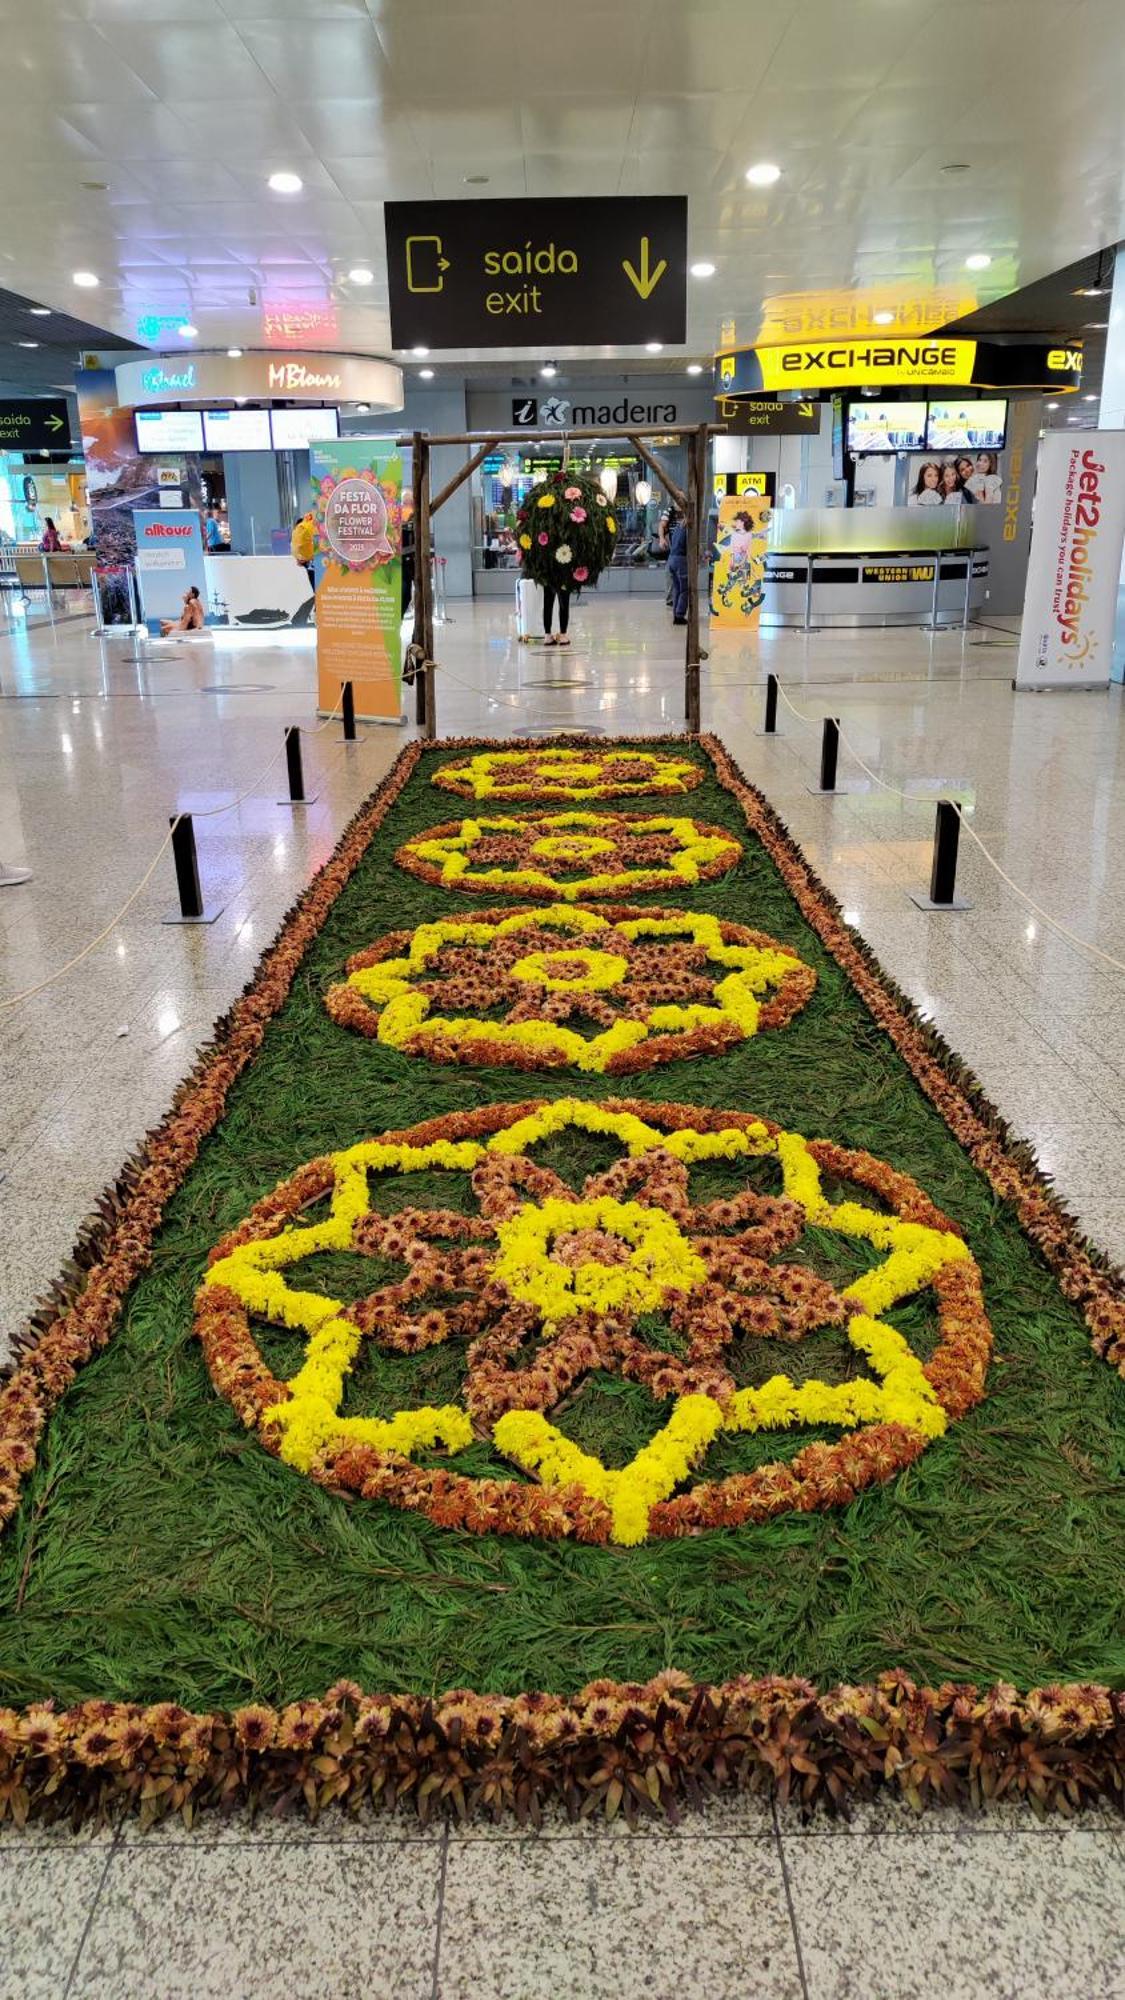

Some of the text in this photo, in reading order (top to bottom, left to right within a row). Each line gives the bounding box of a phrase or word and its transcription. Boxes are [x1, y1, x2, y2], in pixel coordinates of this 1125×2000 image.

[484, 241, 578, 275] saída
[486, 285, 542, 314] exit
[572, 399, 678, 424] madeira
[749, 415, 770, 425] exit
[742, 477, 762, 485] ATM
[340, 491, 371, 502] FESTA
[334, 504, 377, 514] DA FLOR
[339, 517, 373, 526] FLOWER
[145, 524, 193, 536] alltours
[338, 526, 374, 536] FESTIVAL
[1052, 449, 1080, 613] Package holidays you can trust
[1057, 449, 1106, 646] Jet2holidays
[864, 567, 908, 575] WESTERN
